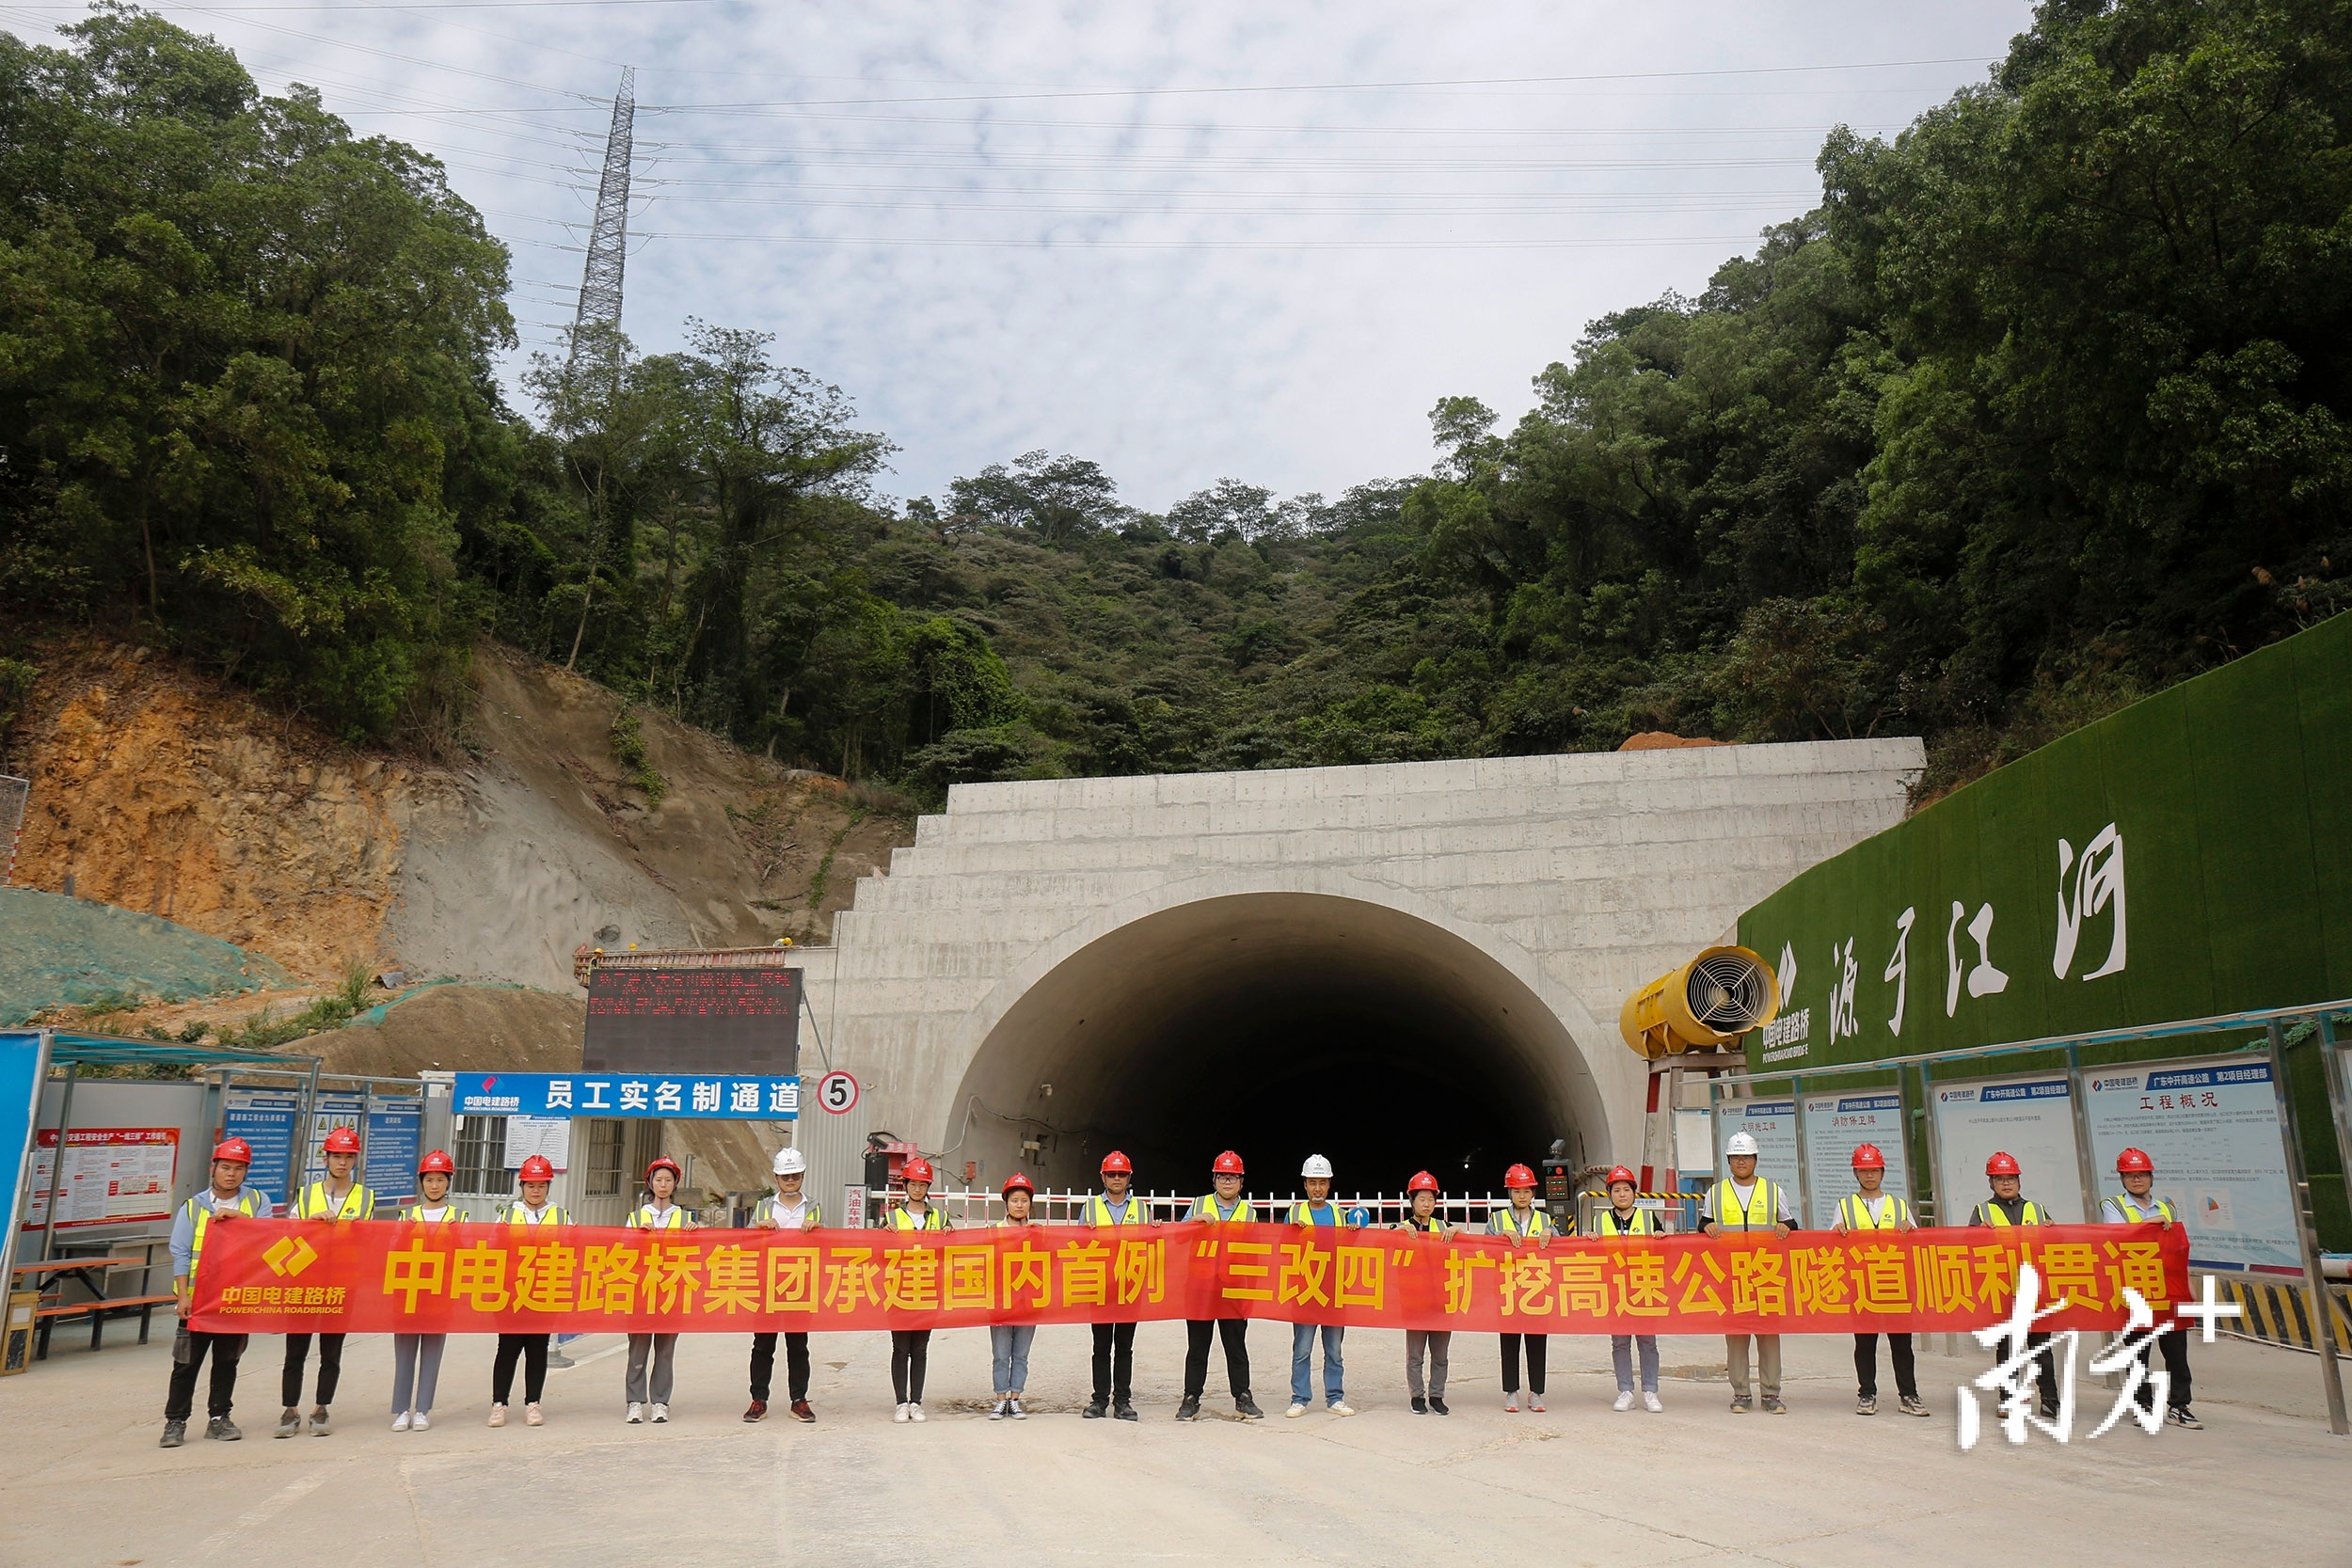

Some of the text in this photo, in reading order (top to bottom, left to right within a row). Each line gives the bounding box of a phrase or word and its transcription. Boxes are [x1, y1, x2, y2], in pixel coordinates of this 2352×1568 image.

[1762, 1007, 1810, 1050] 中国电建路桥
[2103, 1068, 2269, 1088] 中国电建路桥 广东中开高速公路 第2项目经理部
[464, 1096, 520, 1107] 中国电建路桥
[545, 1080, 800, 1113] 员工实名制通道
[829, 1079, 848, 1106] 5
[2139, 1091, 2219, 1111] 工程概况
[1740, 1121, 1777, 1132] 文明施工牌
[1831, 1115, 1876, 1127] 消防保卫牌
[221, 1286, 346, 1306] 中国电建路桥
[219, 1306, 344, 1315] POWERCHINA ROADBRIDGE
